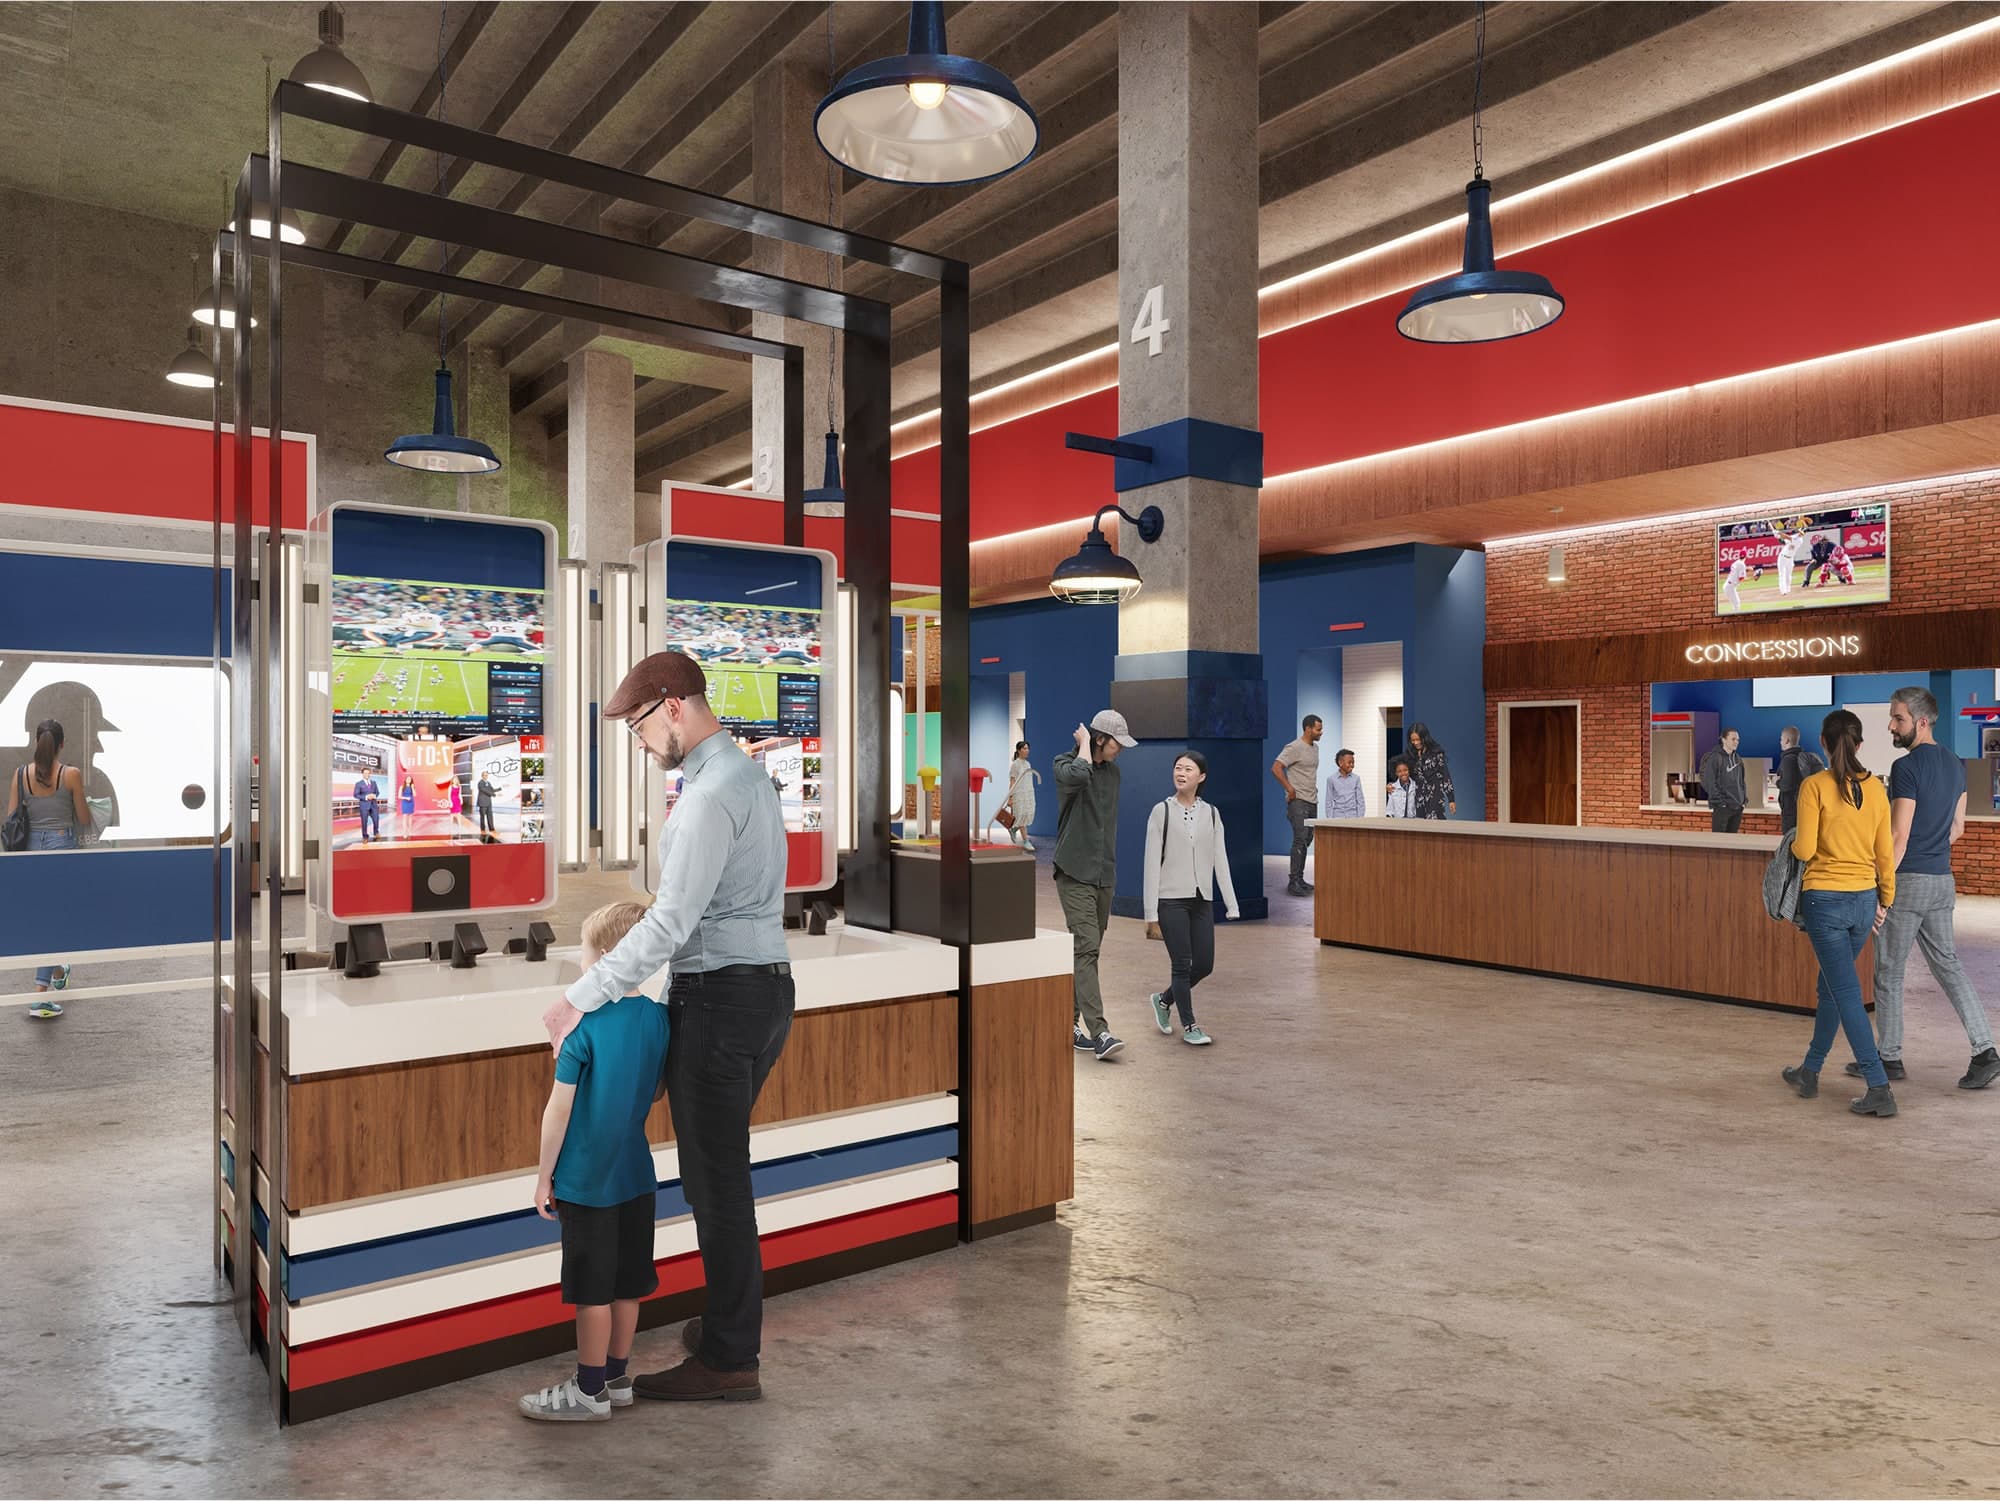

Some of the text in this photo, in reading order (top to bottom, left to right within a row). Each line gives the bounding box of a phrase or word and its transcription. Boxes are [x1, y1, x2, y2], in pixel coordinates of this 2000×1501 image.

[1131, 284, 1171, 358] 4
[757, 446, 774, 493] 3
[1685, 634, 1861, 664] CONCESSIONS
